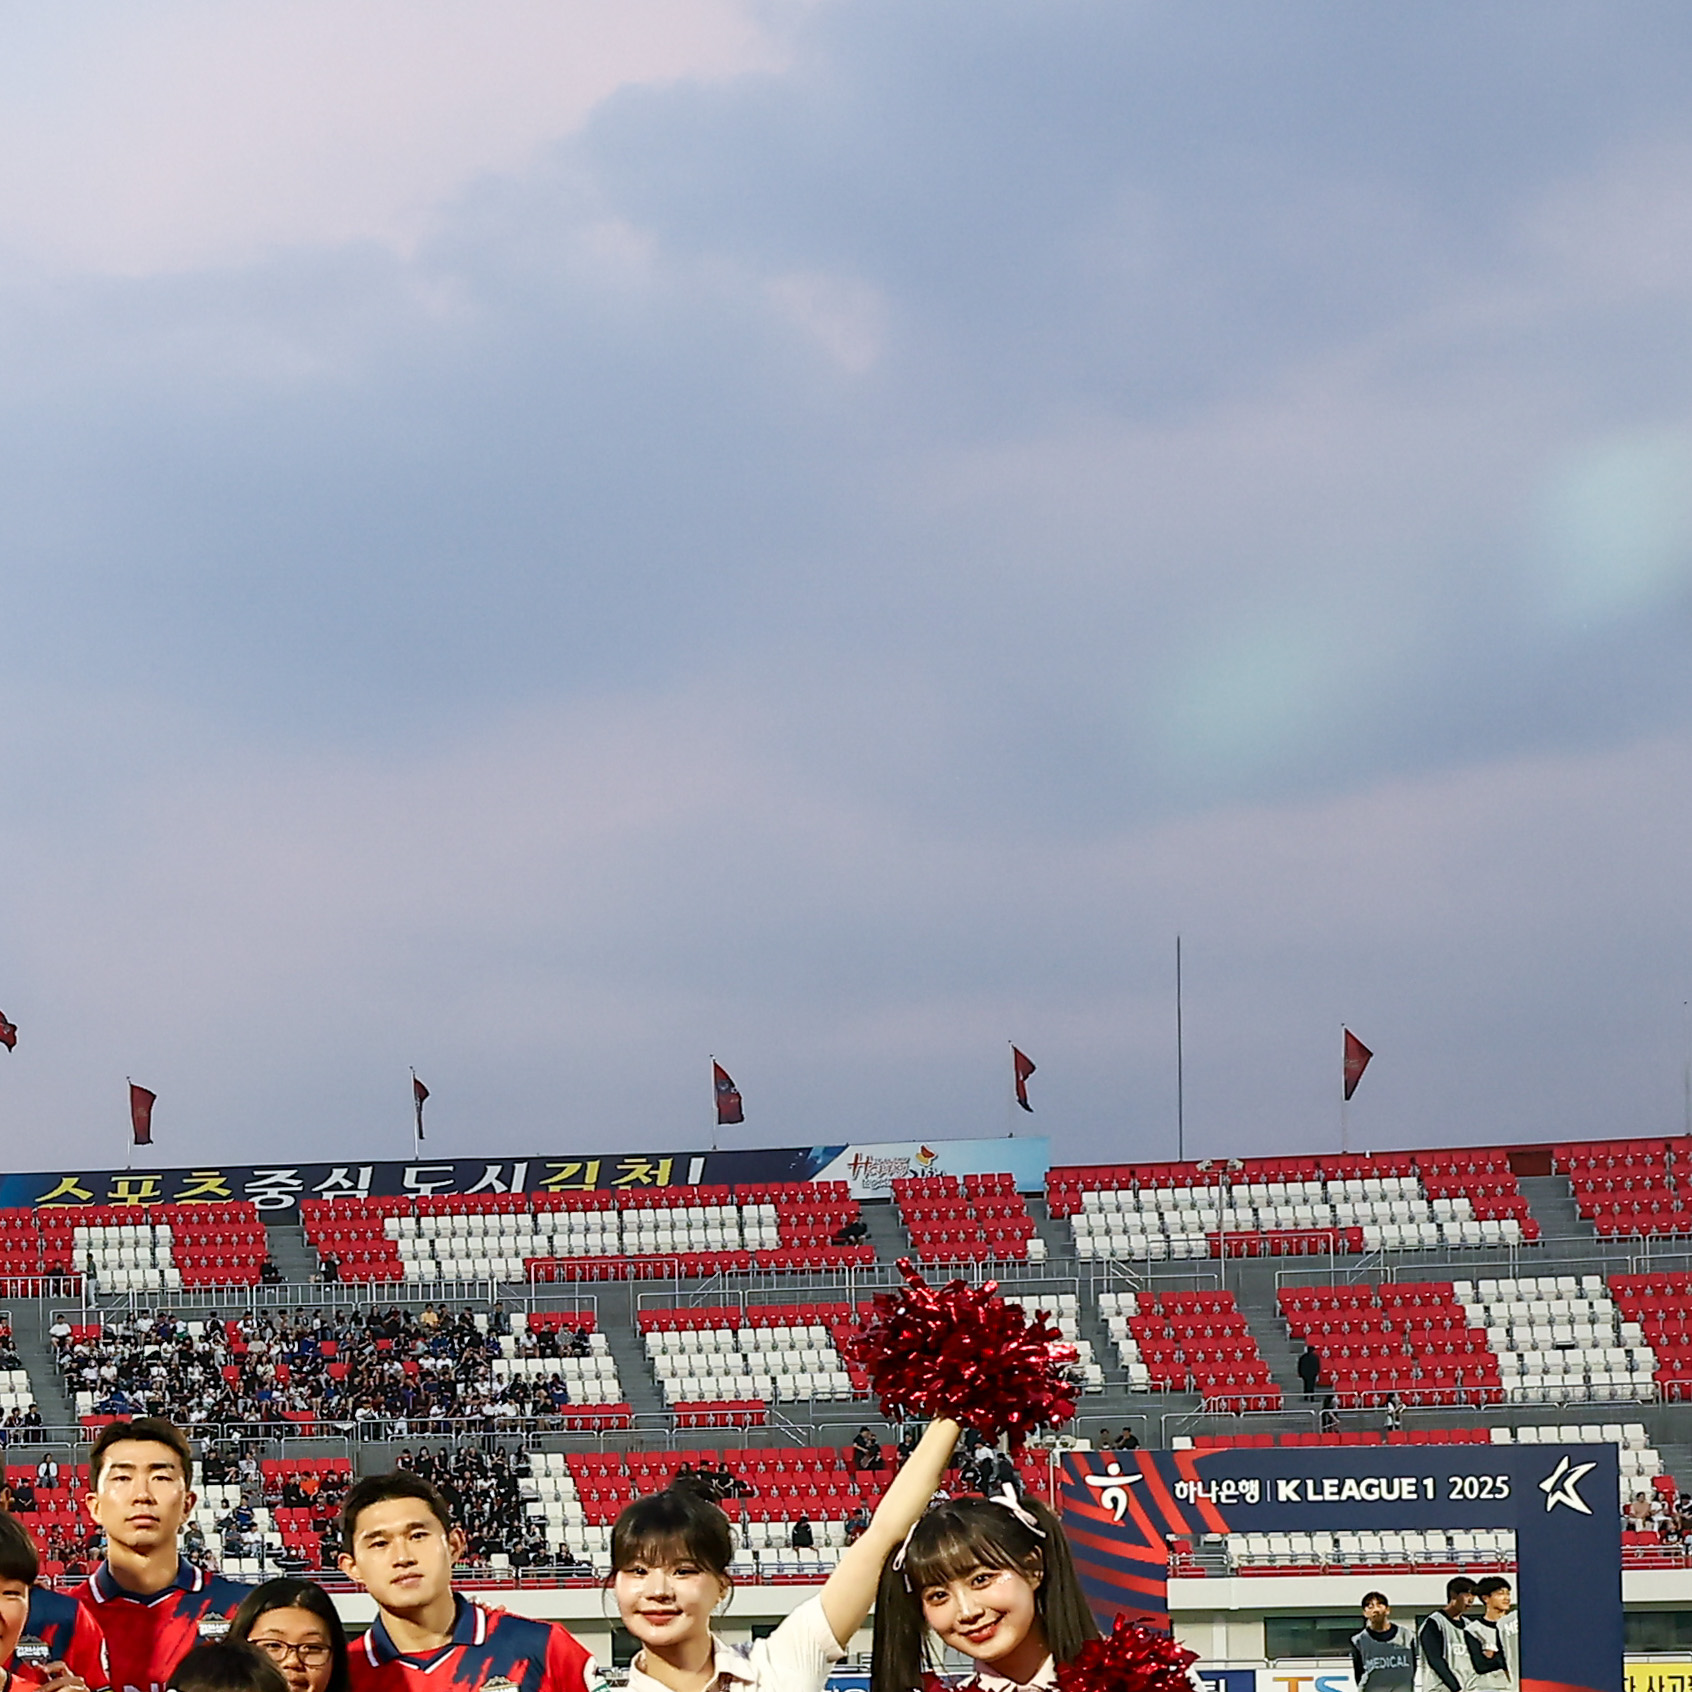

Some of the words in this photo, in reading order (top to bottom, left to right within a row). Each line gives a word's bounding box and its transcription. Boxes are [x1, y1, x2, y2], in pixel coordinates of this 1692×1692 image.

[1174, 1479, 1260, 1504] 하나은행
[1277, 1480, 1302, 1502] K
[1306, 1477, 1418, 1502] LEAGUE
[1422, 1477, 1435, 1500] 1
[1449, 1475, 1511, 1501] 2025
[1365, 1655, 1410, 1670] MEDICAL
